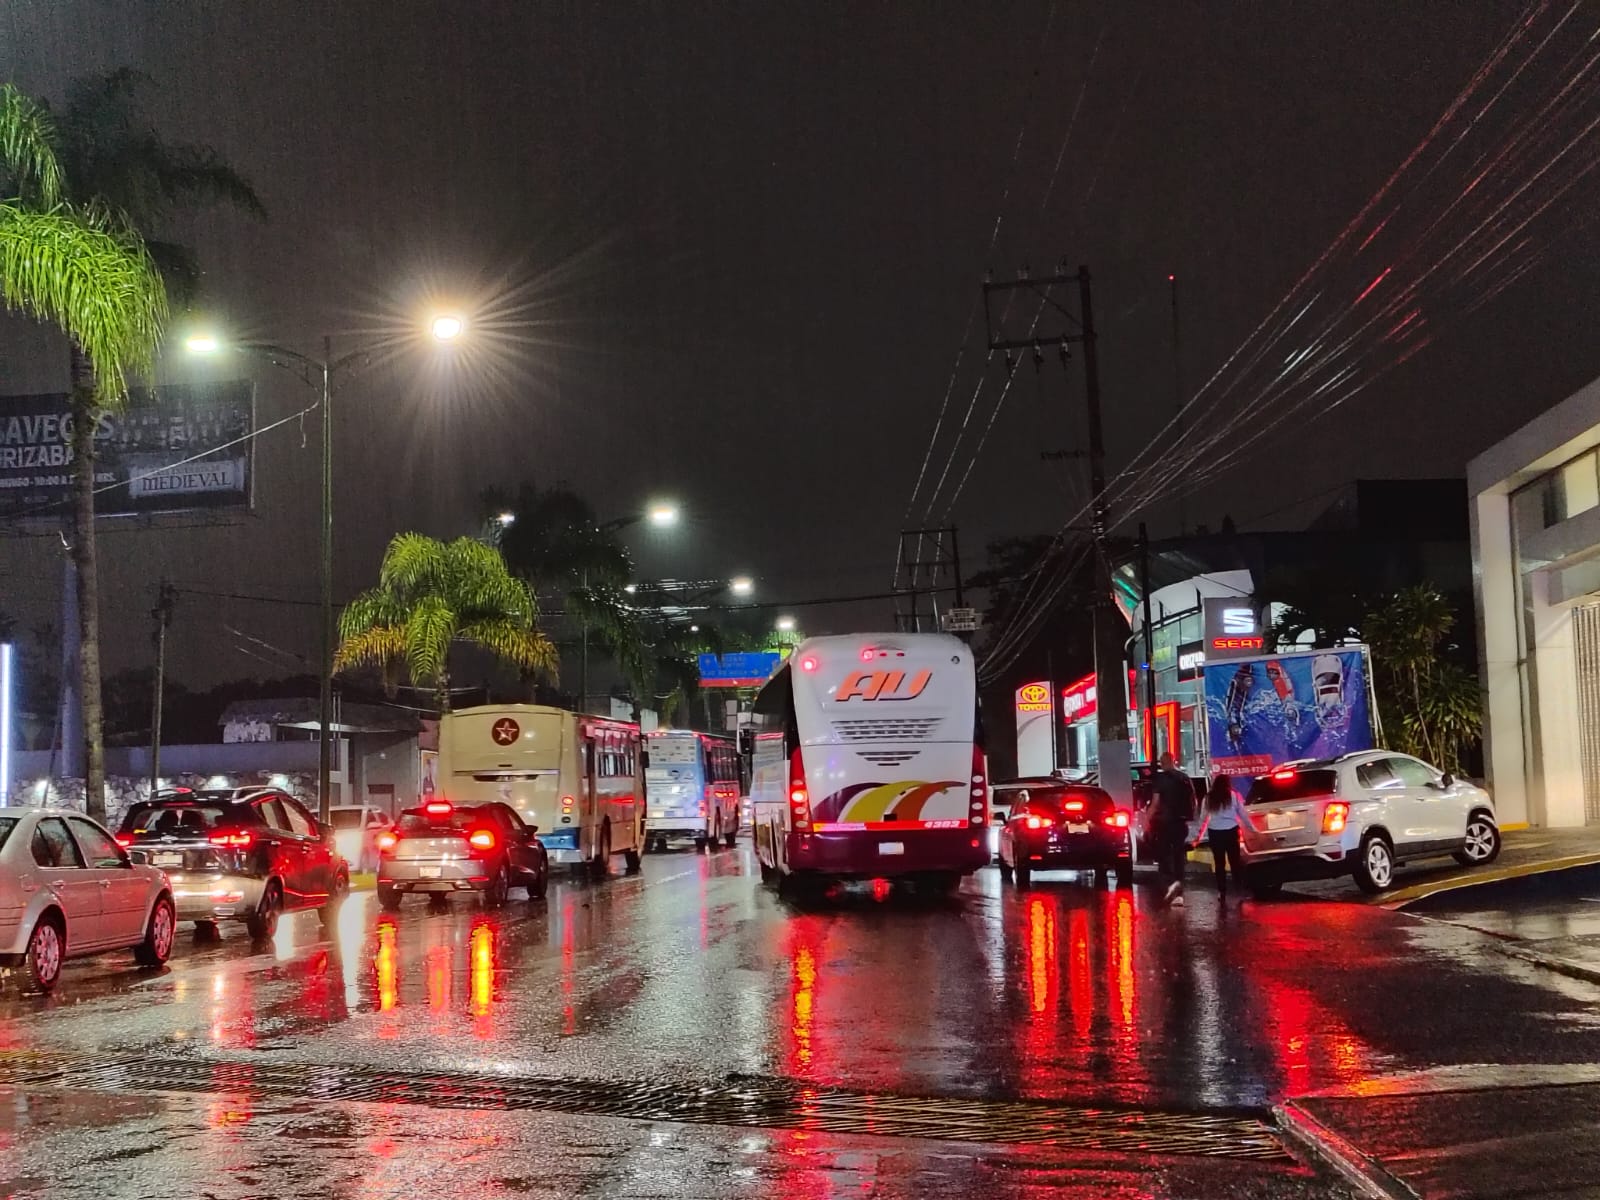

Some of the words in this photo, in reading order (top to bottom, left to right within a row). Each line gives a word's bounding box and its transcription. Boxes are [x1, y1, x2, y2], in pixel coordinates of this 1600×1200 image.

[0, 445, 75, 469] RIZABA
[143, 471, 232, 491] MEDIEVAL
[1213, 638, 1263, 649] SEAT
[835, 671, 932, 702] AU
